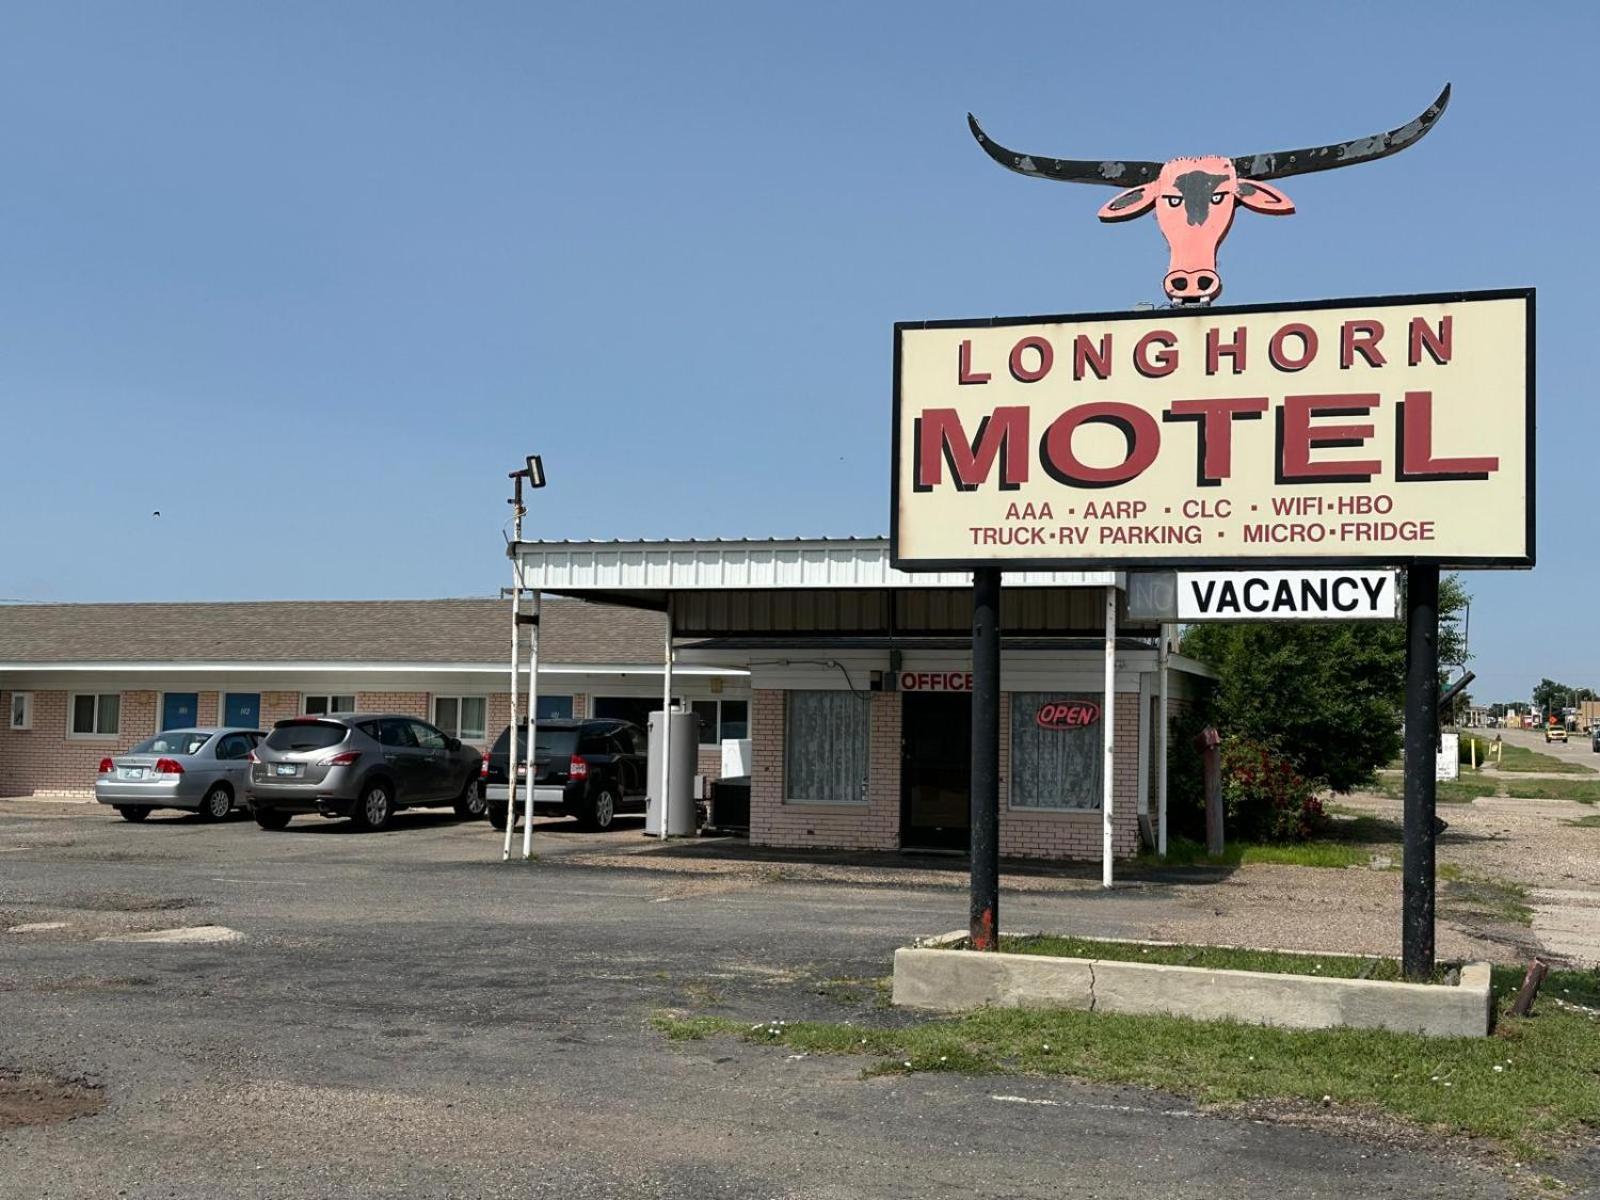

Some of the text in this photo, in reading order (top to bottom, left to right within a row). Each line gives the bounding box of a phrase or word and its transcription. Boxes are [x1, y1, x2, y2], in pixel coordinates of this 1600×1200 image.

[958, 315, 1453, 385] LONGHORN
[913, 391, 1500, 493] MOTEL
[1005, 502, 1054, 521] AAA
[1083, 500, 1147, 520] AARP
[1182, 499, 1232, 519] CLC
[1100, 524, 1202, 545] PARKING
[1191, 576, 1387, 613] VACANCY
[1040, 704, 1094, 725] OPEN
